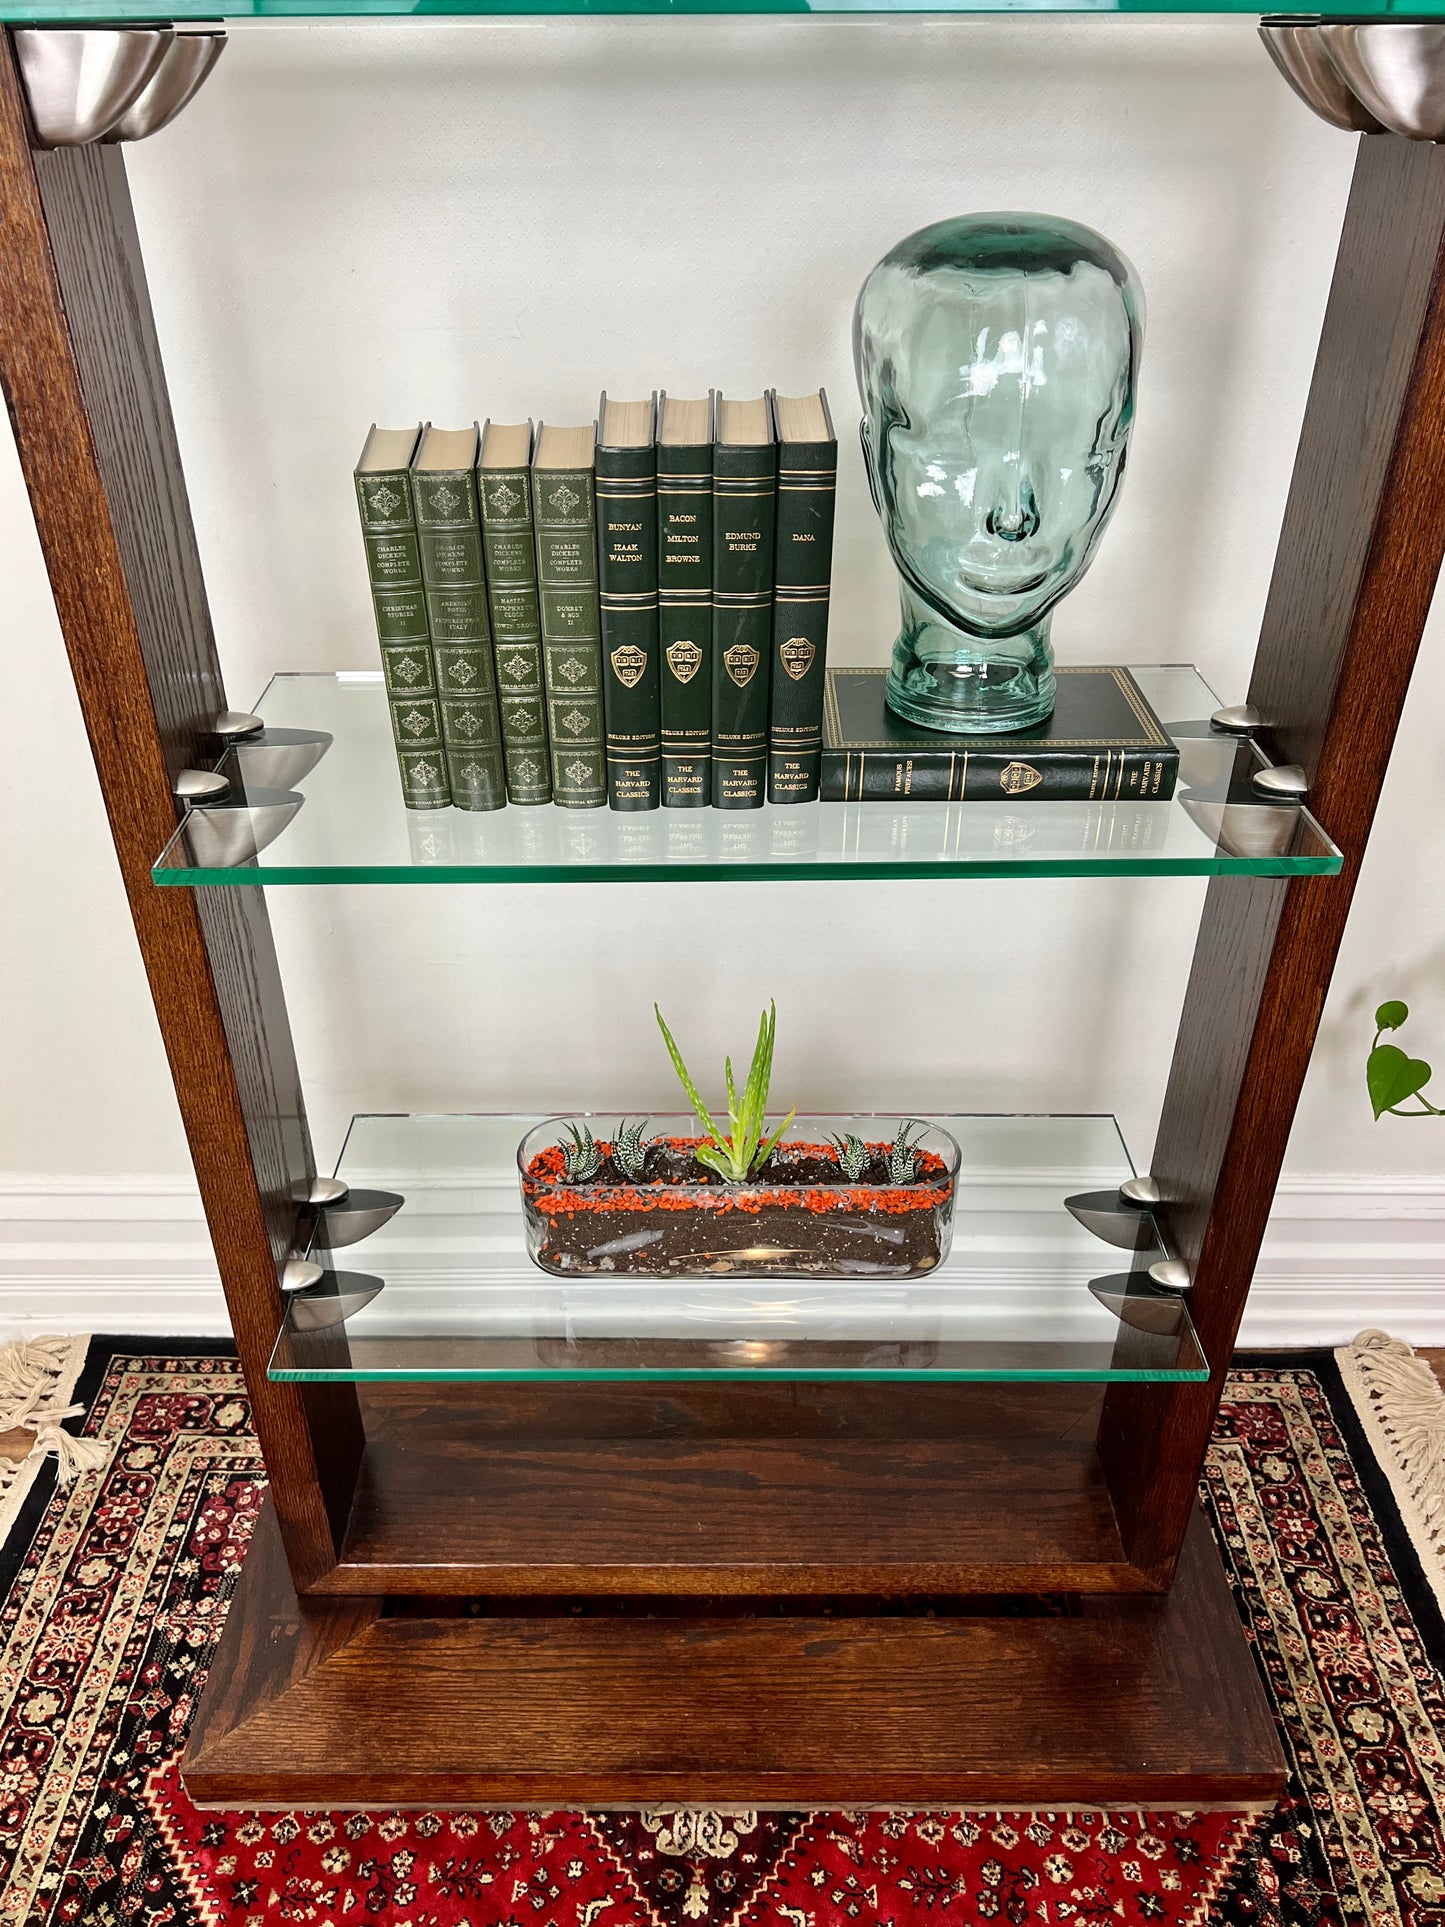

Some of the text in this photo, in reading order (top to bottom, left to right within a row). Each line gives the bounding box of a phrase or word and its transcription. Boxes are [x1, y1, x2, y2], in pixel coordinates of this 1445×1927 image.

[608, 523, 643, 531] BUNYAN
[725, 532, 761, 540] EDMUND
[894, 763, 903, 792] FAMOUS
[904, 760, 913, 795] PREFACES
[1130, 770, 1138, 786] THE
[1140, 761, 1151, 794] HARVARD
[1152, 762, 1163, 794] CLASSICS
